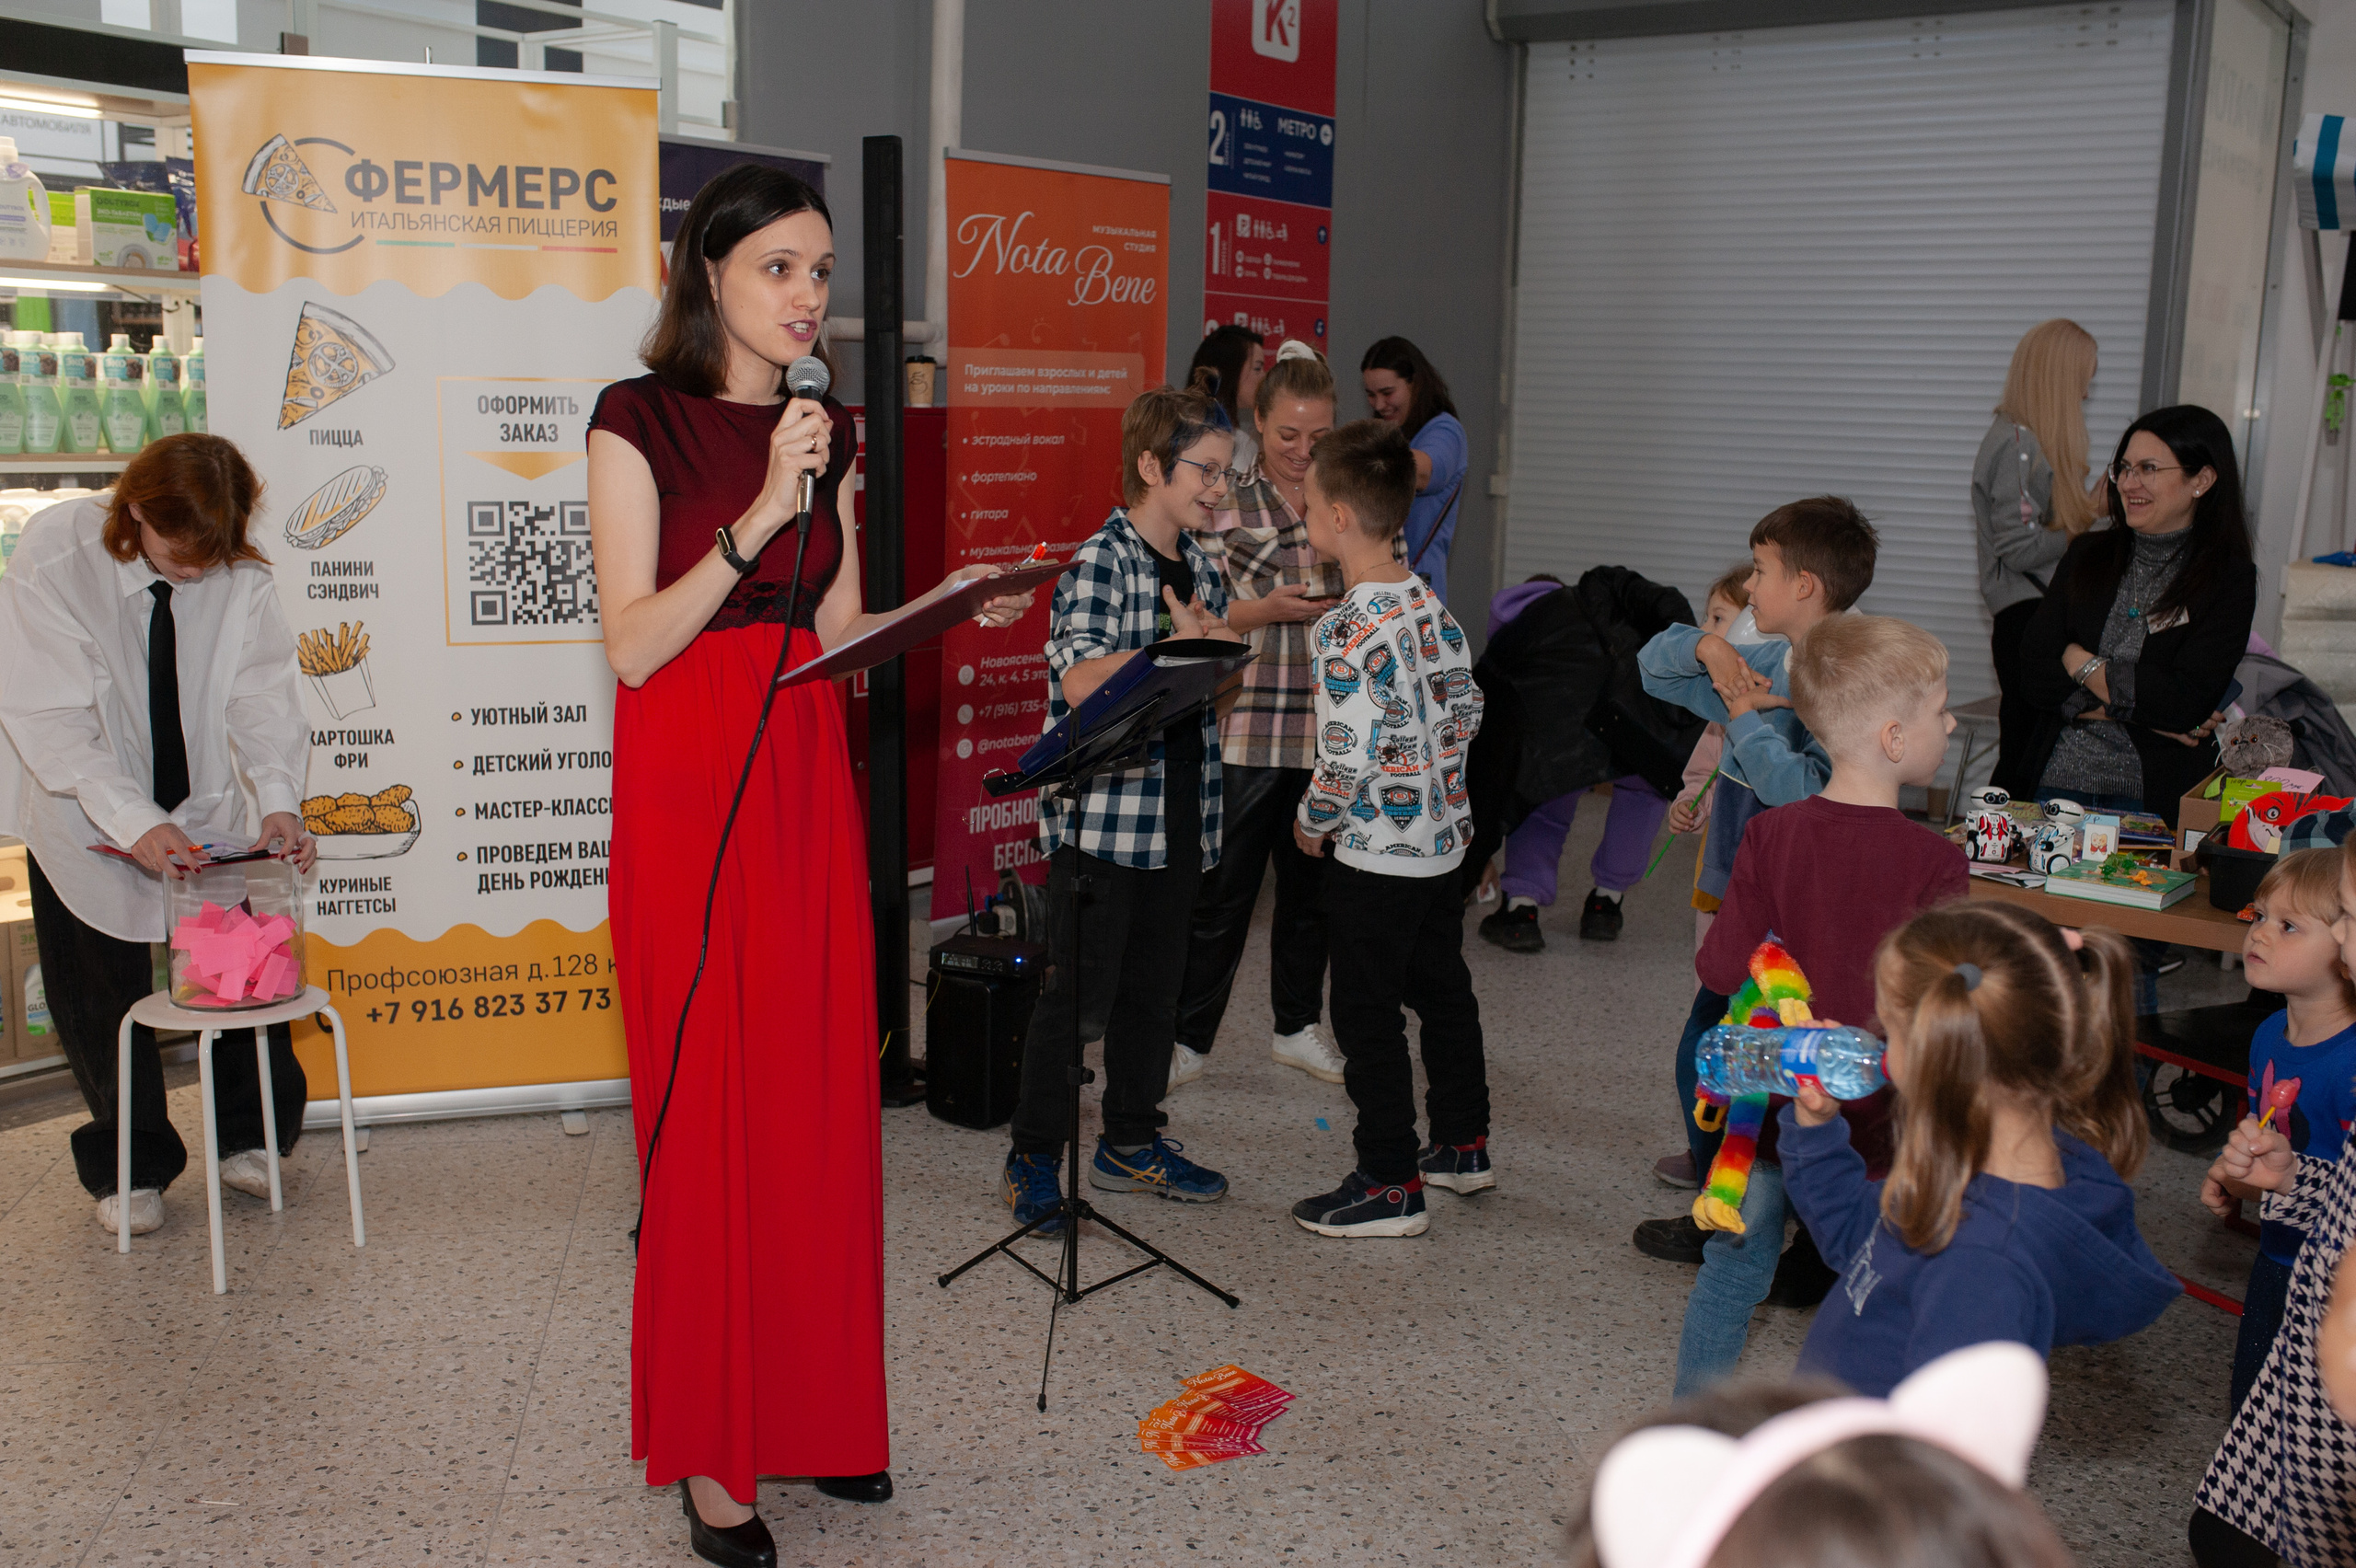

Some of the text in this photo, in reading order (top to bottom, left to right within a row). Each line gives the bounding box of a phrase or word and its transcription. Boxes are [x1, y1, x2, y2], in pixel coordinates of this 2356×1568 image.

[1276, 117, 1317, 140] МЕТРО
[1209, 110, 1226, 166] 2
[344, 158, 618, 213] ФЕРМЕРС
[351, 211, 618, 238] ИТАЛЬЯНСКАЯ ПИЦЦЕРИЯ
[1092, 225, 1157, 238] МУЗЫКАЛЬНАЯ
[1124, 242, 1156, 253] СТУДИЯ
[1209, 222, 1220, 274] 1
[953, 211, 1070, 279] Nota
[1068, 245, 1157, 306] Bene
[964, 363, 1127, 380] Приглашаем взрослых и детей
[964, 383, 979, 392] на
[981, 384, 1013, 396] уроки
[1017, 385, 1030, 393] по
[477, 394, 580, 416] ОФОРМИТЬ
[309, 429, 364, 448] ПИЦЦА
[500, 423, 559, 443] ЗАКАЗ
[972, 433, 1065, 447] эстрадный вокал
[971, 470, 1037, 485] фортепиано
[970, 510, 1009, 522] гитара
[311, 561, 374, 577] ПАНИНИ
[307, 583, 379, 601] СЭНДВИЧ
[1342, 622, 1376, 659] AMERICAN
[1356, 627, 1380, 650] FOOTBALL
[979, 674, 996, 686] 24,
[1022, 670, 1030, 681] 5
[1448, 688, 1471, 698] OTBALL
[471, 702, 587, 726] УЮТНЫЙ ЗАЛ
[978, 699, 1050, 719] +7 (916) 735-6
[1324, 721, 1354, 733] AMERICAN
[310, 729, 395, 746] КАРТОШКА
[334, 753, 368, 768] ФРИ
[473, 749, 612, 776] ДЕТСКИЙ УГОЛО
[1320, 790, 1350, 800] FOOTBALL
[475, 797, 613, 820] МАСТЕР-КЛАСС
[477, 841, 572, 864] ПРОВЕДЕМ
[1385, 843, 1422, 852] AMERICAN
[319, 877, 392, 894] КУРИНЫЕ
[478, 868, 608, 894] ДЕНЬ РОЖДЕН
[317, 898, 397, 916] НАГГЕТСЫ
[20, 934, 38, 945] ЭК
[328, 964, 518, 997] Профсоюзная
[28, 1002, 46, 1012] GLO
[366, 987, 611, 1024] +7 916 823 37 73
